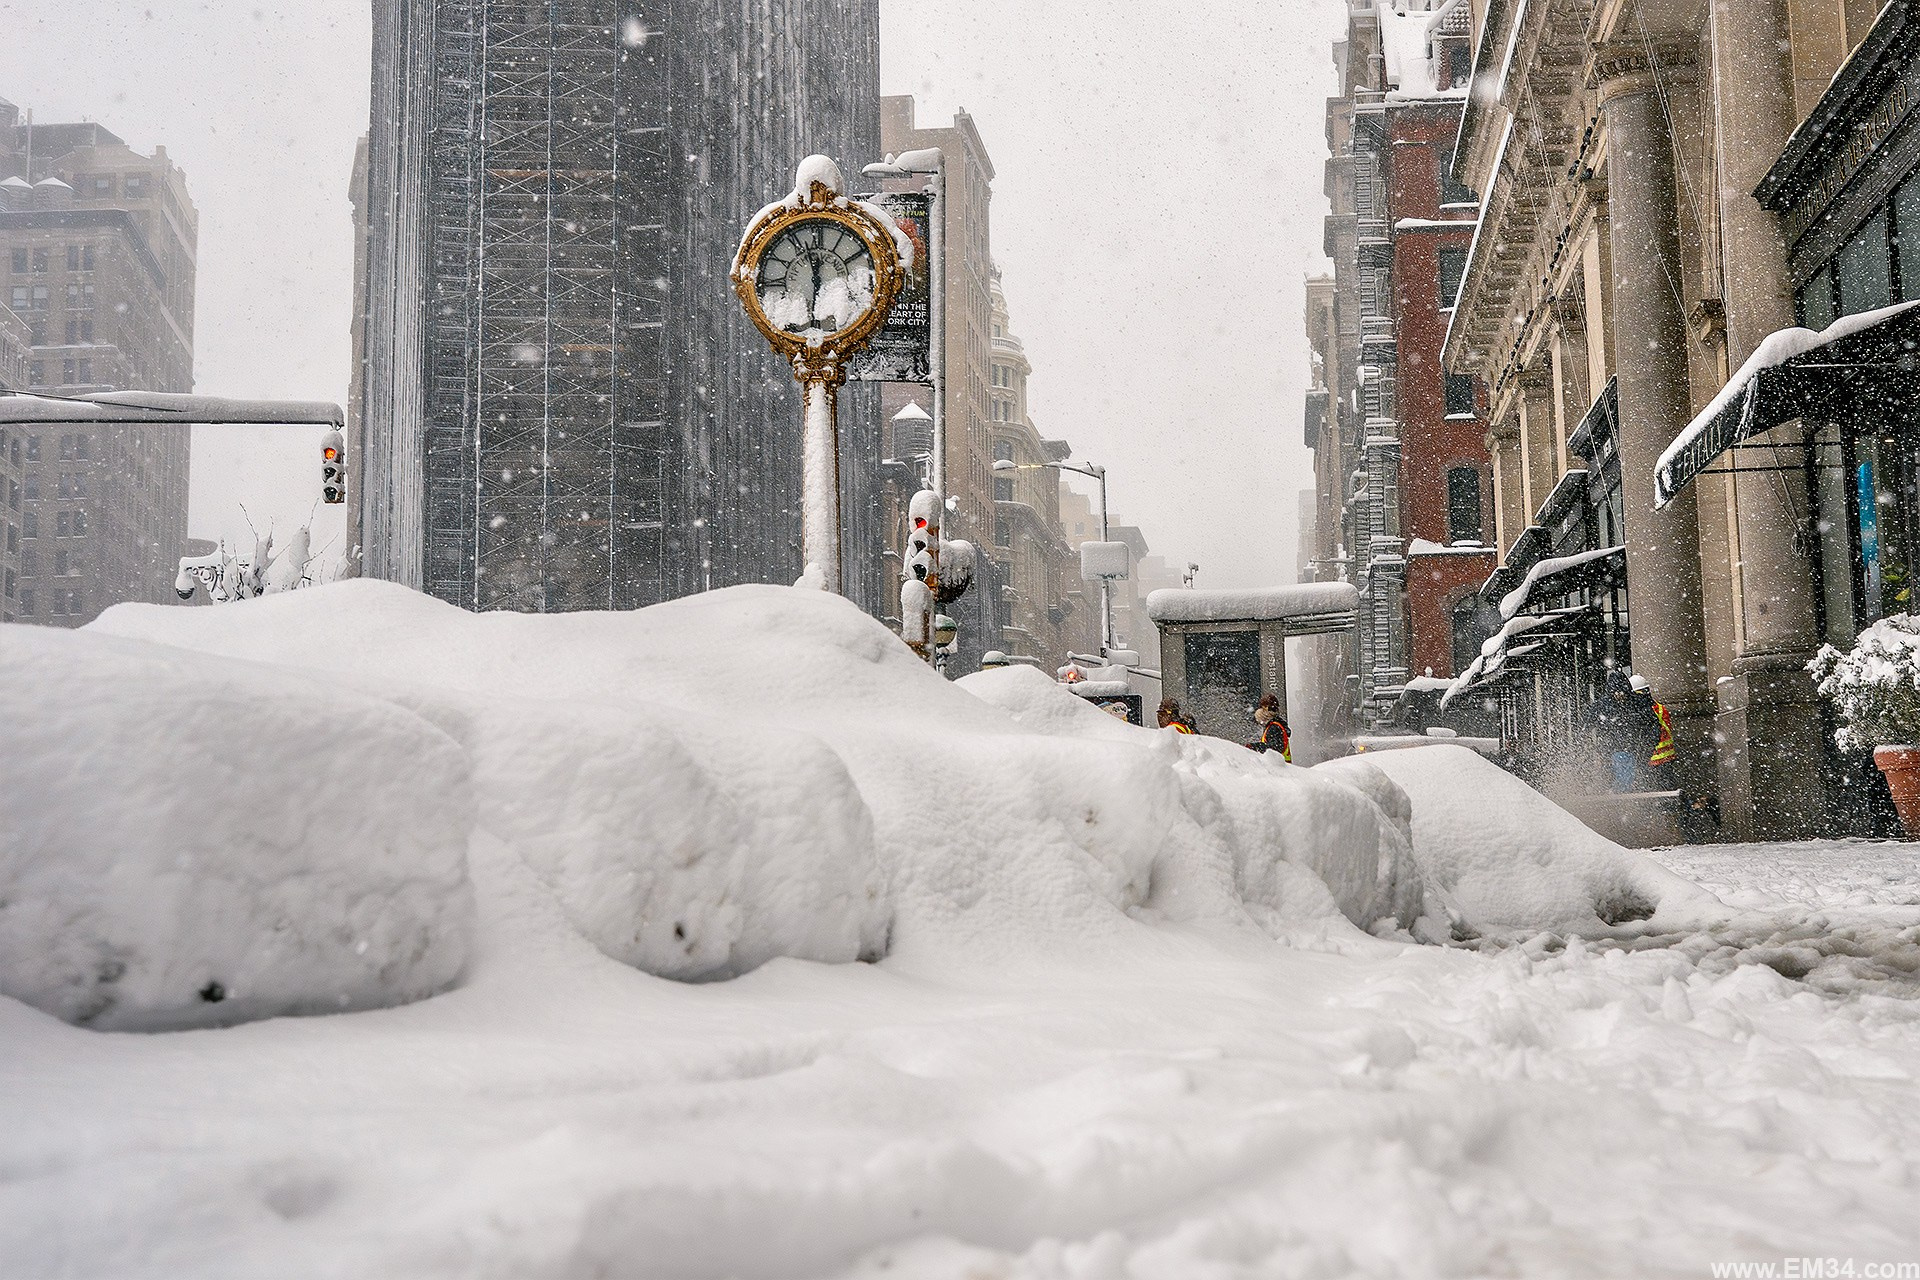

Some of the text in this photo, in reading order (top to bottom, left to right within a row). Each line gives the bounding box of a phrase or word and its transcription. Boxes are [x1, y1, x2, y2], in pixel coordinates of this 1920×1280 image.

[812, 251, 846, 278] VENUE
[910, 303, 927, 311] THE
[889, 310, 927, 319] EART OF
[907, 318, 927, 326] CITY
[1681, 414, 1723, 481] EATALY
